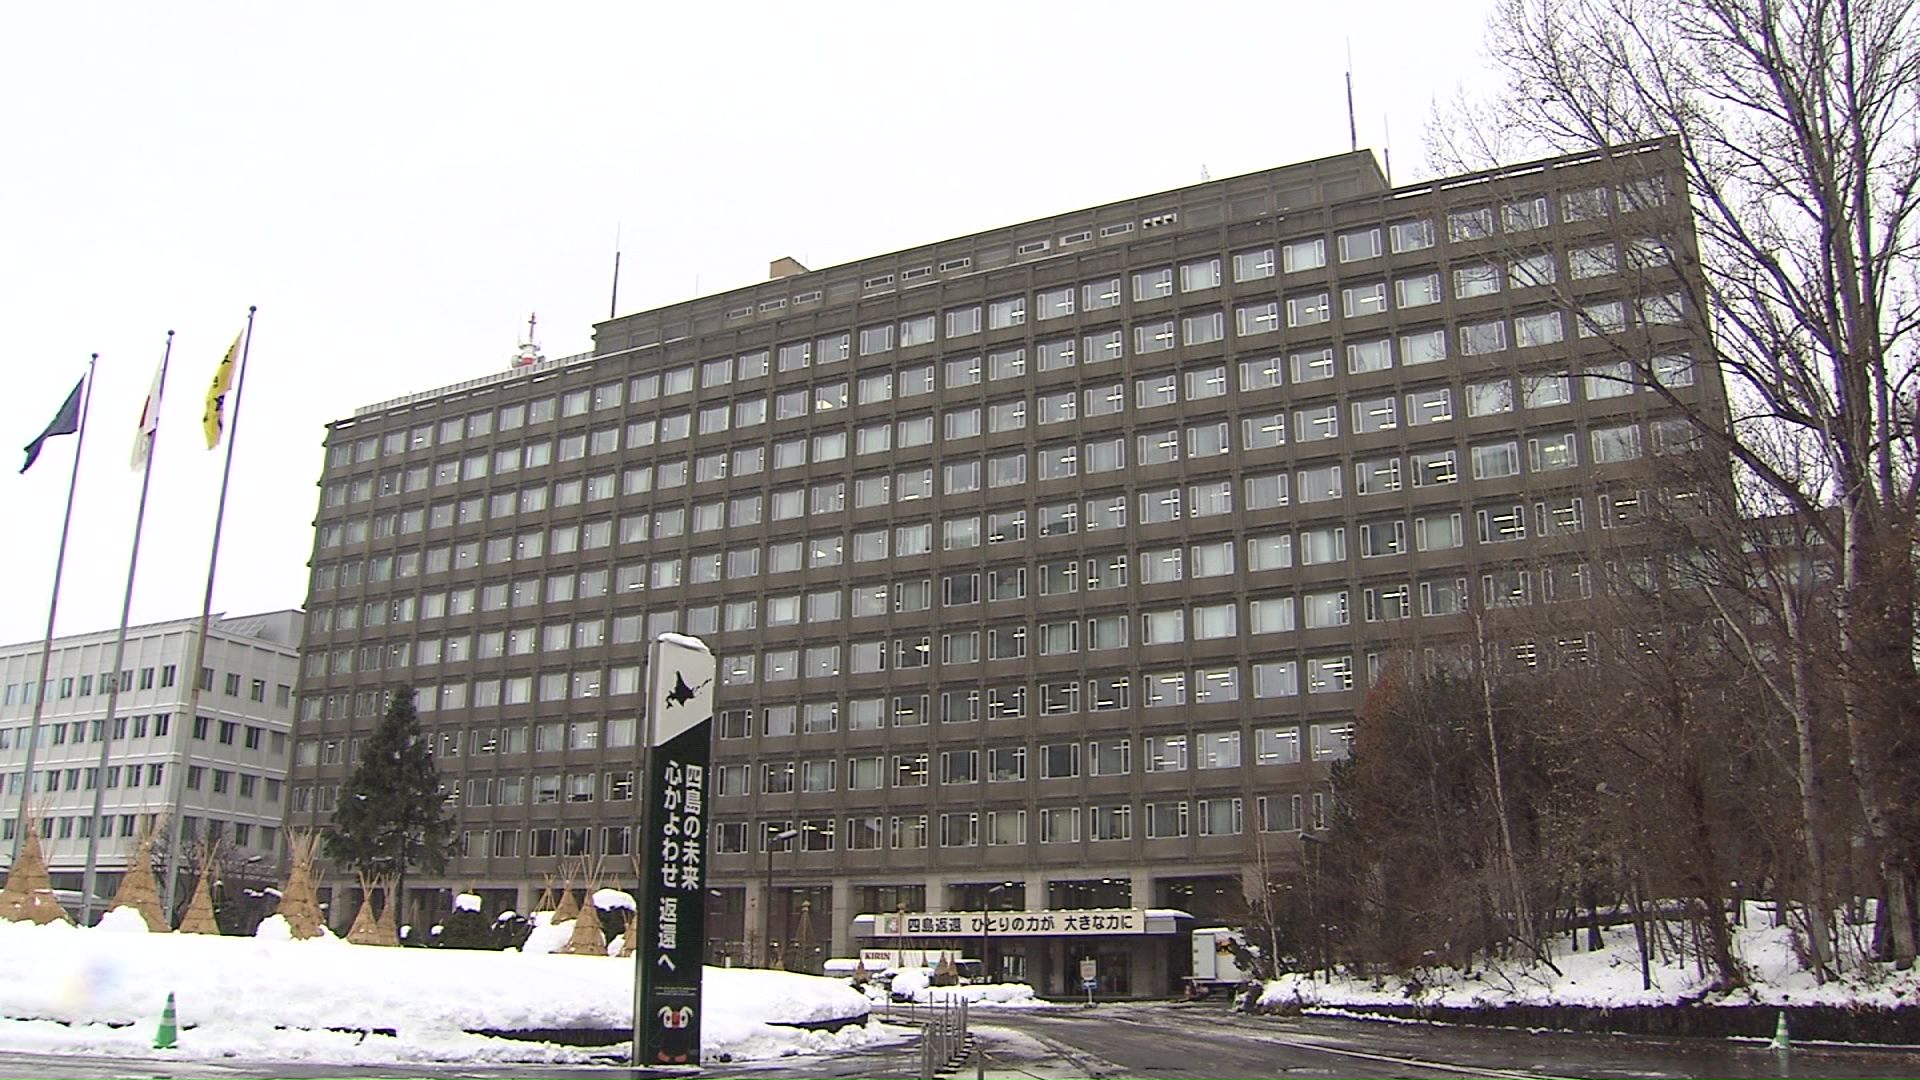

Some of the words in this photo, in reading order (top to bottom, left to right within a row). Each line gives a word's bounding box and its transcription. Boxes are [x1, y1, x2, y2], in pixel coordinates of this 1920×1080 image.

[661, 759, 683, 888] 心かよわせ
[681, 764, 703, 891] 四島の未来
[657, 896, 678, 972] 返還へ
[864, 951, 892, 961] KIRIN
[907, 917, 962, 933] 四島返還
[971, 916, 1055, 933] ひとりの力が
[1064, 914, 1134, 931] 大きな力に
